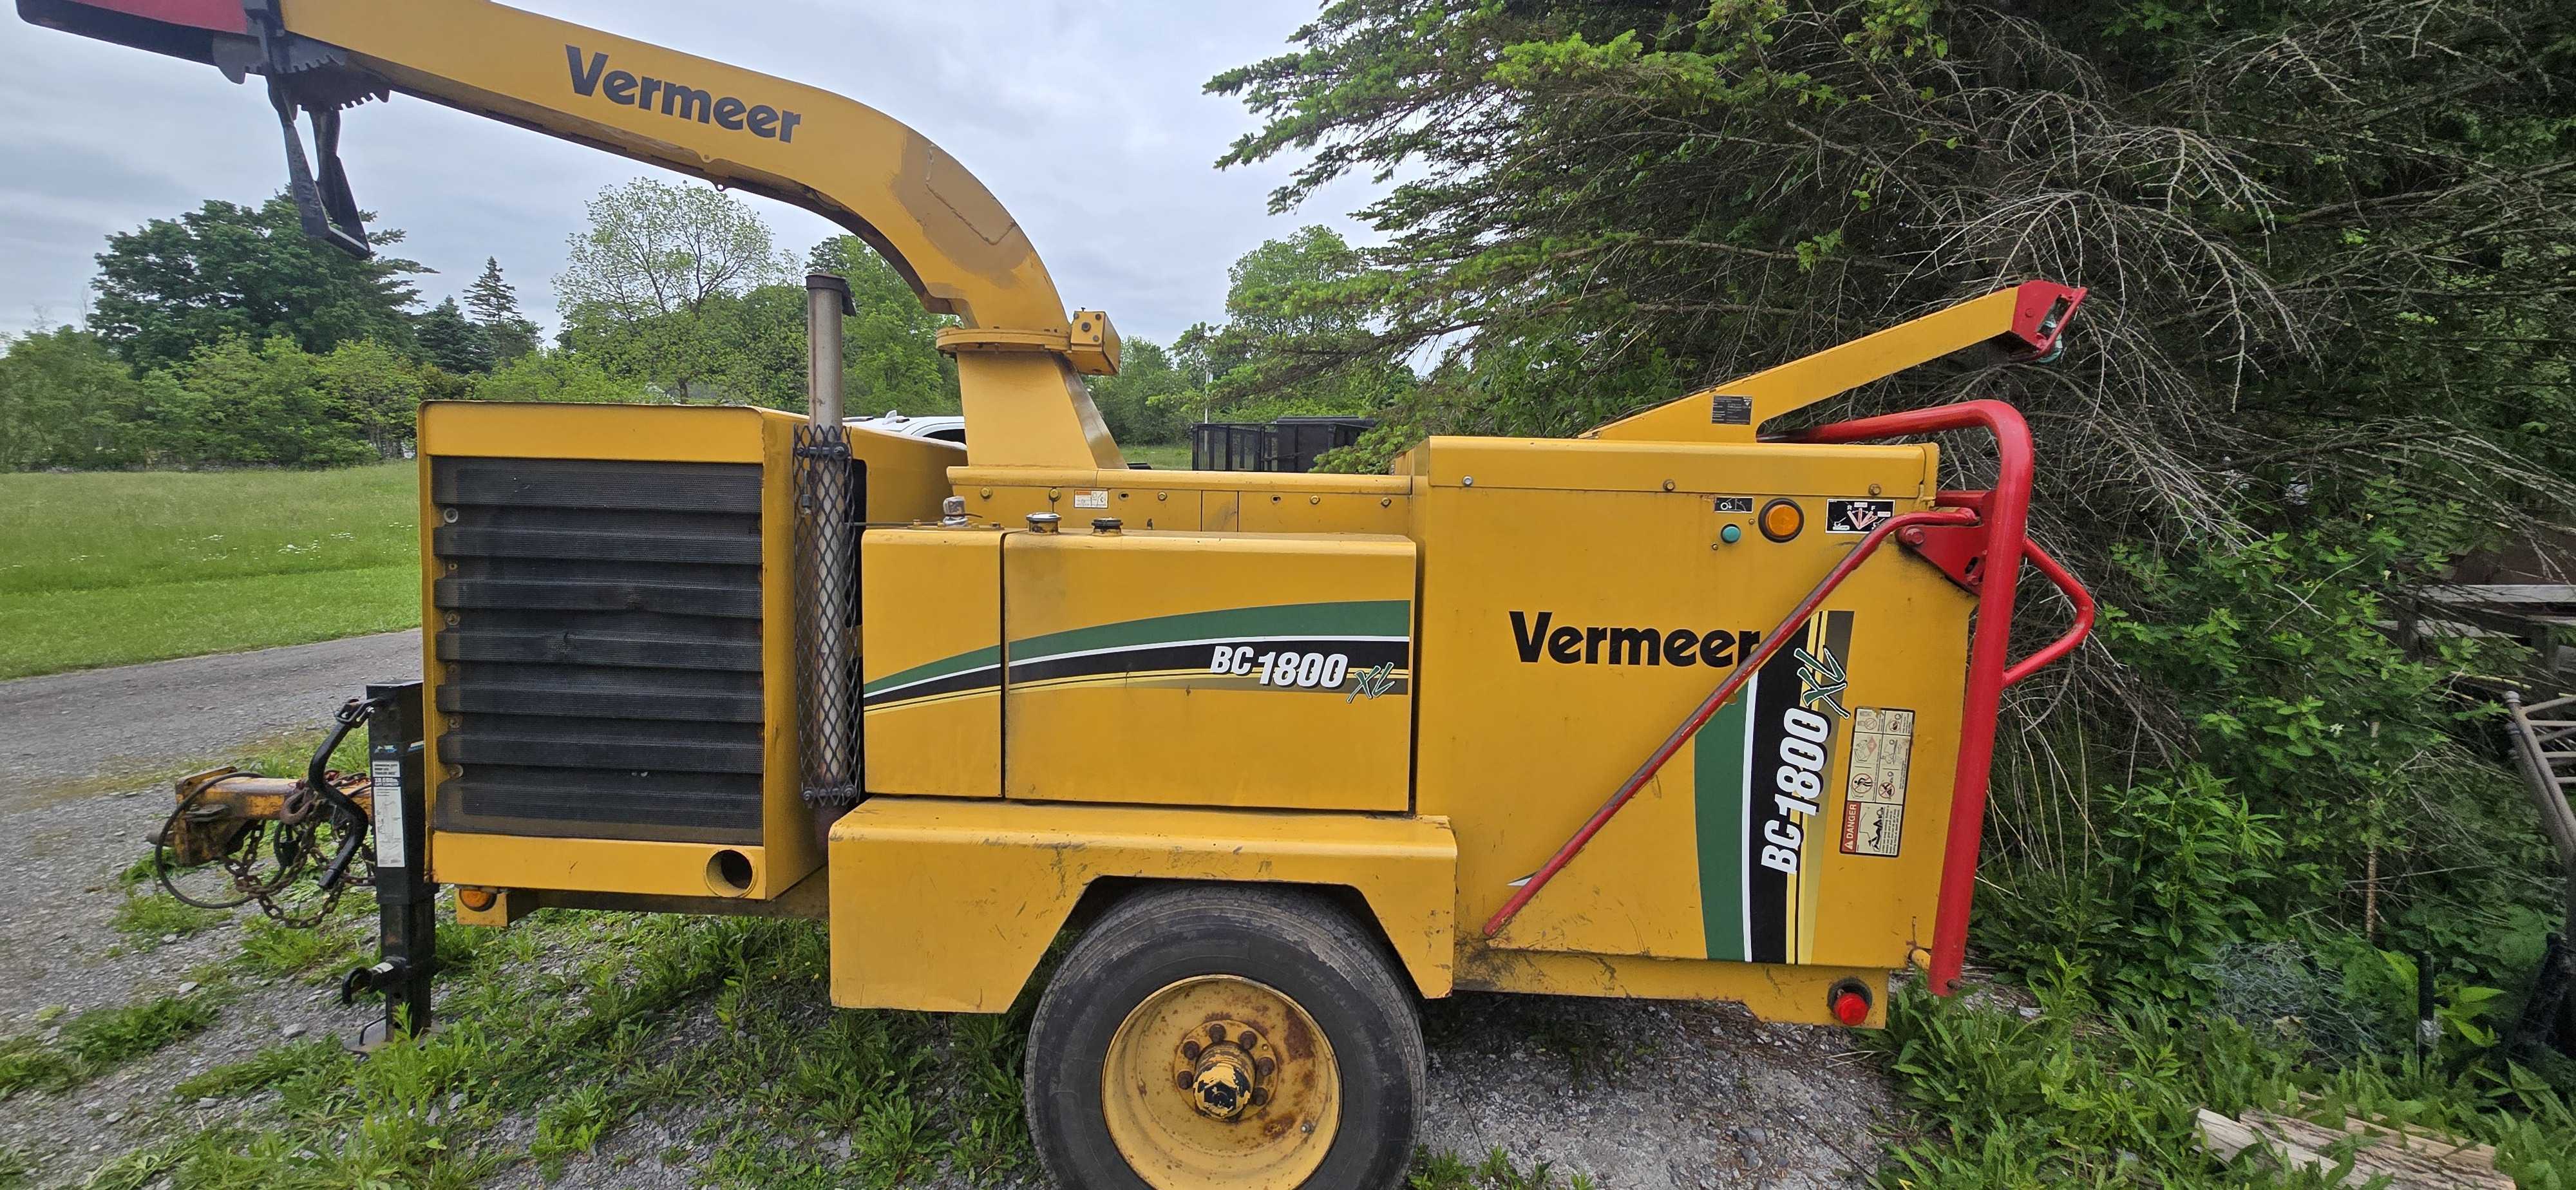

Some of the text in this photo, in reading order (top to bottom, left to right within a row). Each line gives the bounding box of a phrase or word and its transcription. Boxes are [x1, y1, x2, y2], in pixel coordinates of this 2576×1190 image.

[565, 44, 801, 143] Vermeer
[1509, 611, 1760, 668] Vermeer
[1346, 662, 1396, 703] XL
[1794, 647, 1851, 719] XL
[1846, 804, 1857, 839] DANGER
